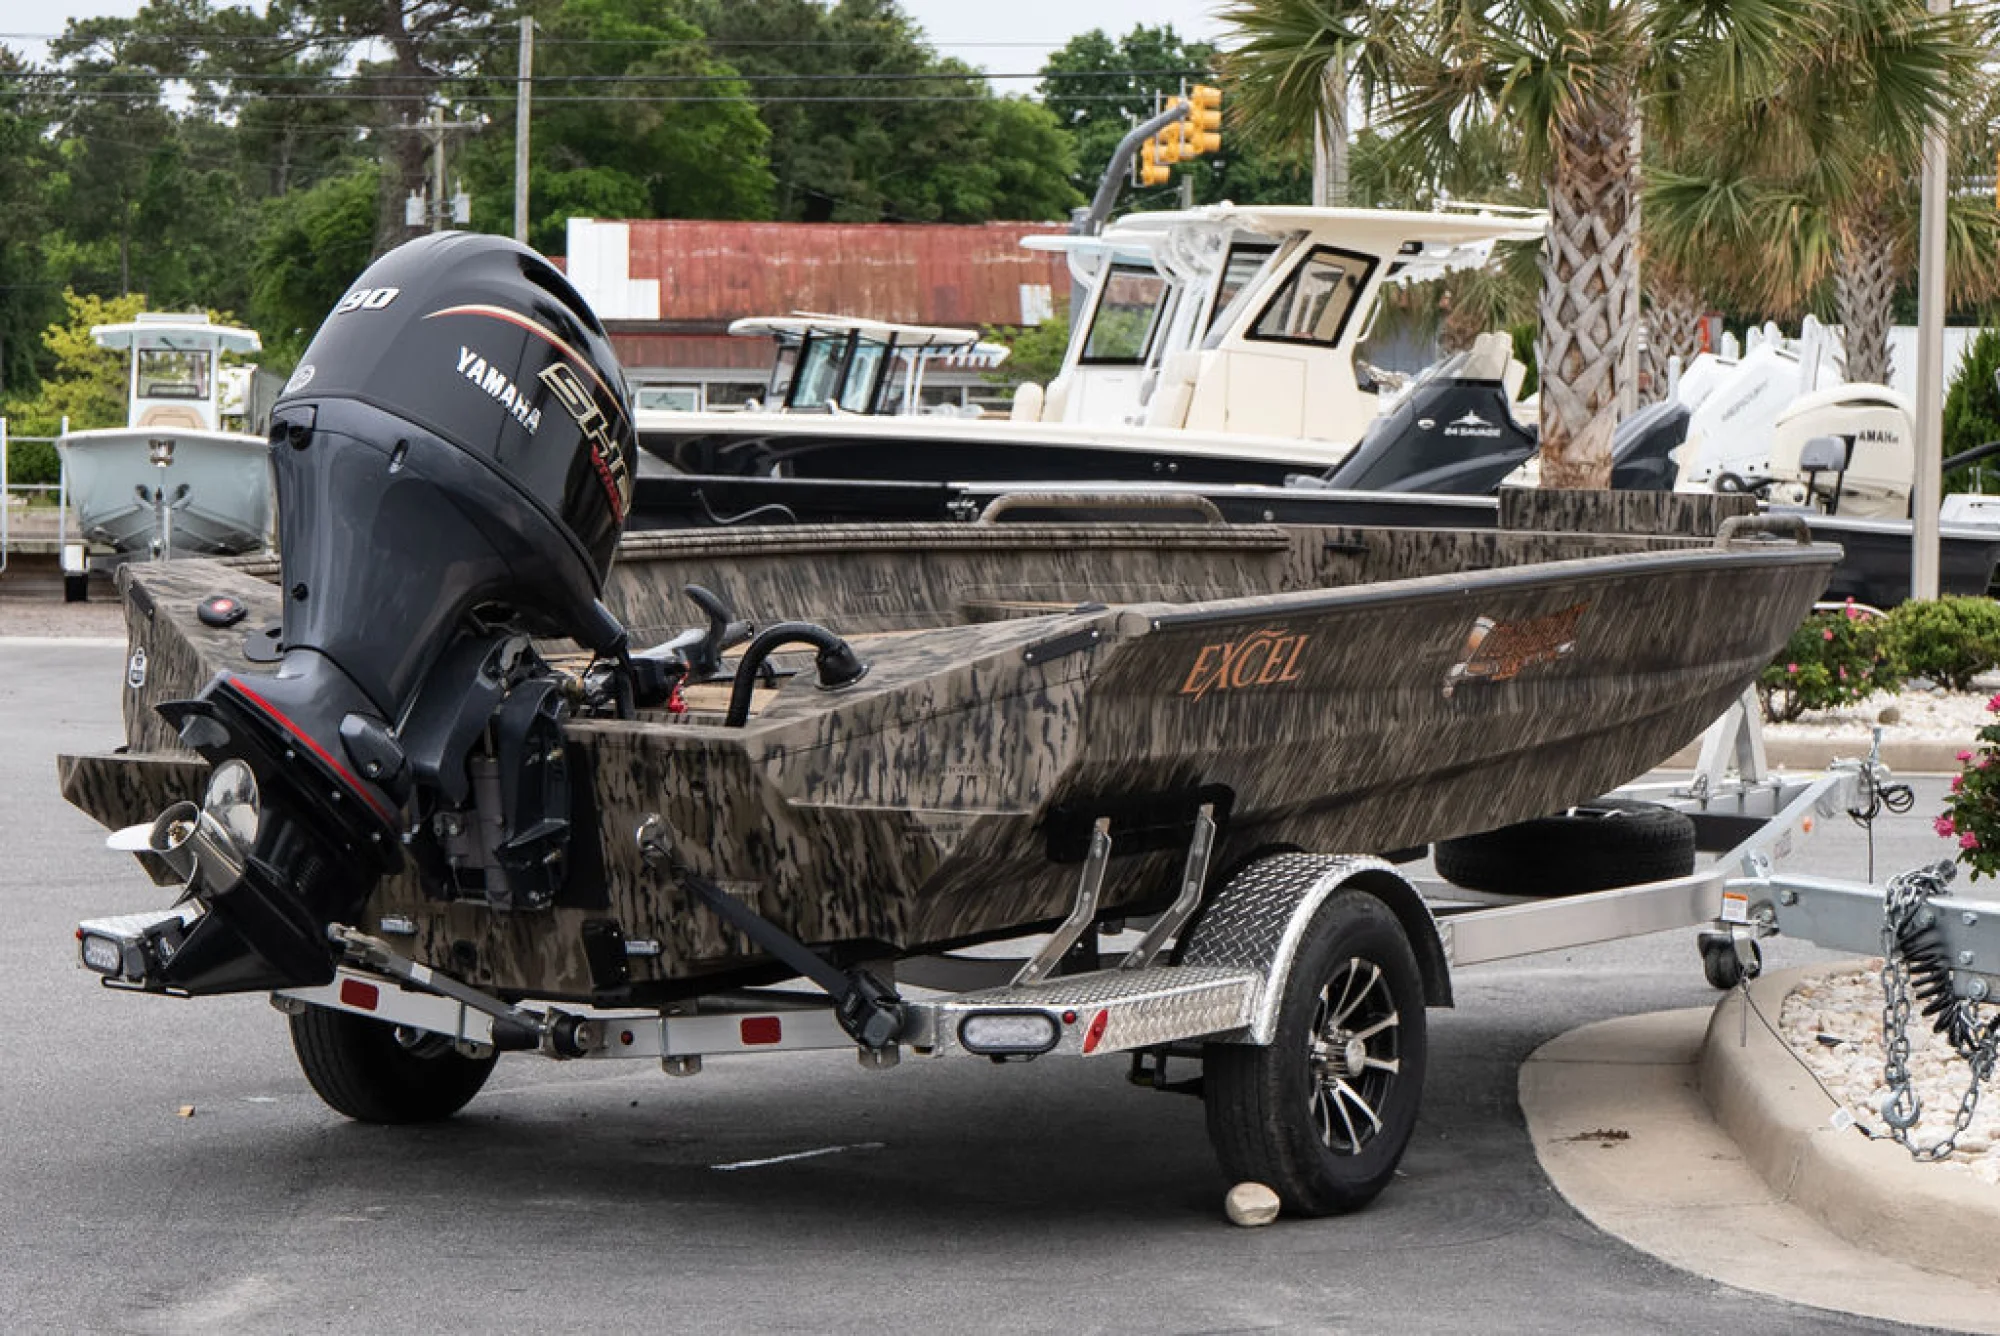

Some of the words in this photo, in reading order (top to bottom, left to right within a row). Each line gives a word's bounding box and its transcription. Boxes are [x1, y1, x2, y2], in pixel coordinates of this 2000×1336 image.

[337, 287, 400, 315] 90
[456, 345, 542, 436] YAMAHA
[1178, 628, 1310, 703] EXCEL
